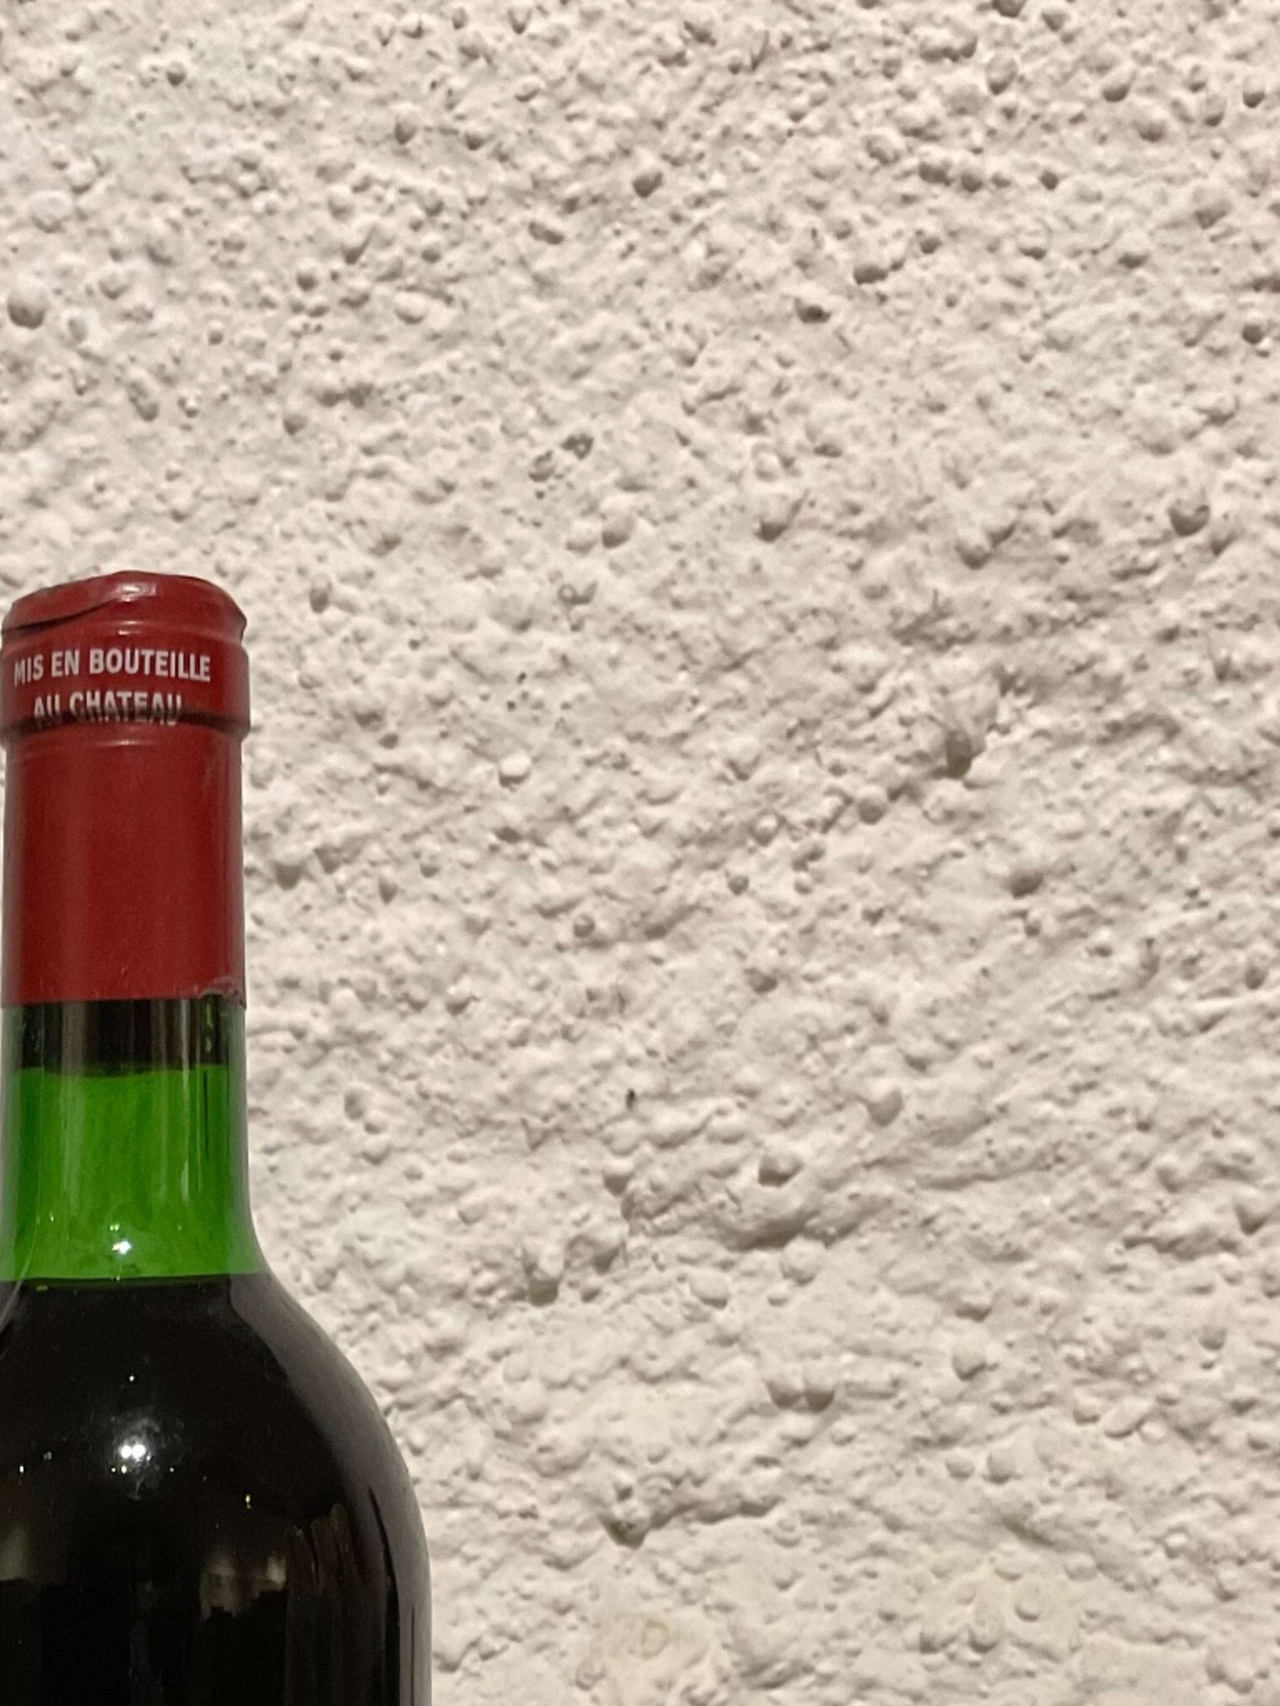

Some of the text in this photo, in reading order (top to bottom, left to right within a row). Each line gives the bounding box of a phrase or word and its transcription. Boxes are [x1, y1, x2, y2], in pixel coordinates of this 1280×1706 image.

[14, 648, 211, 687] MIS EN BOUTEILLE
[33, 691, 182, 729] AU CHATEAU
